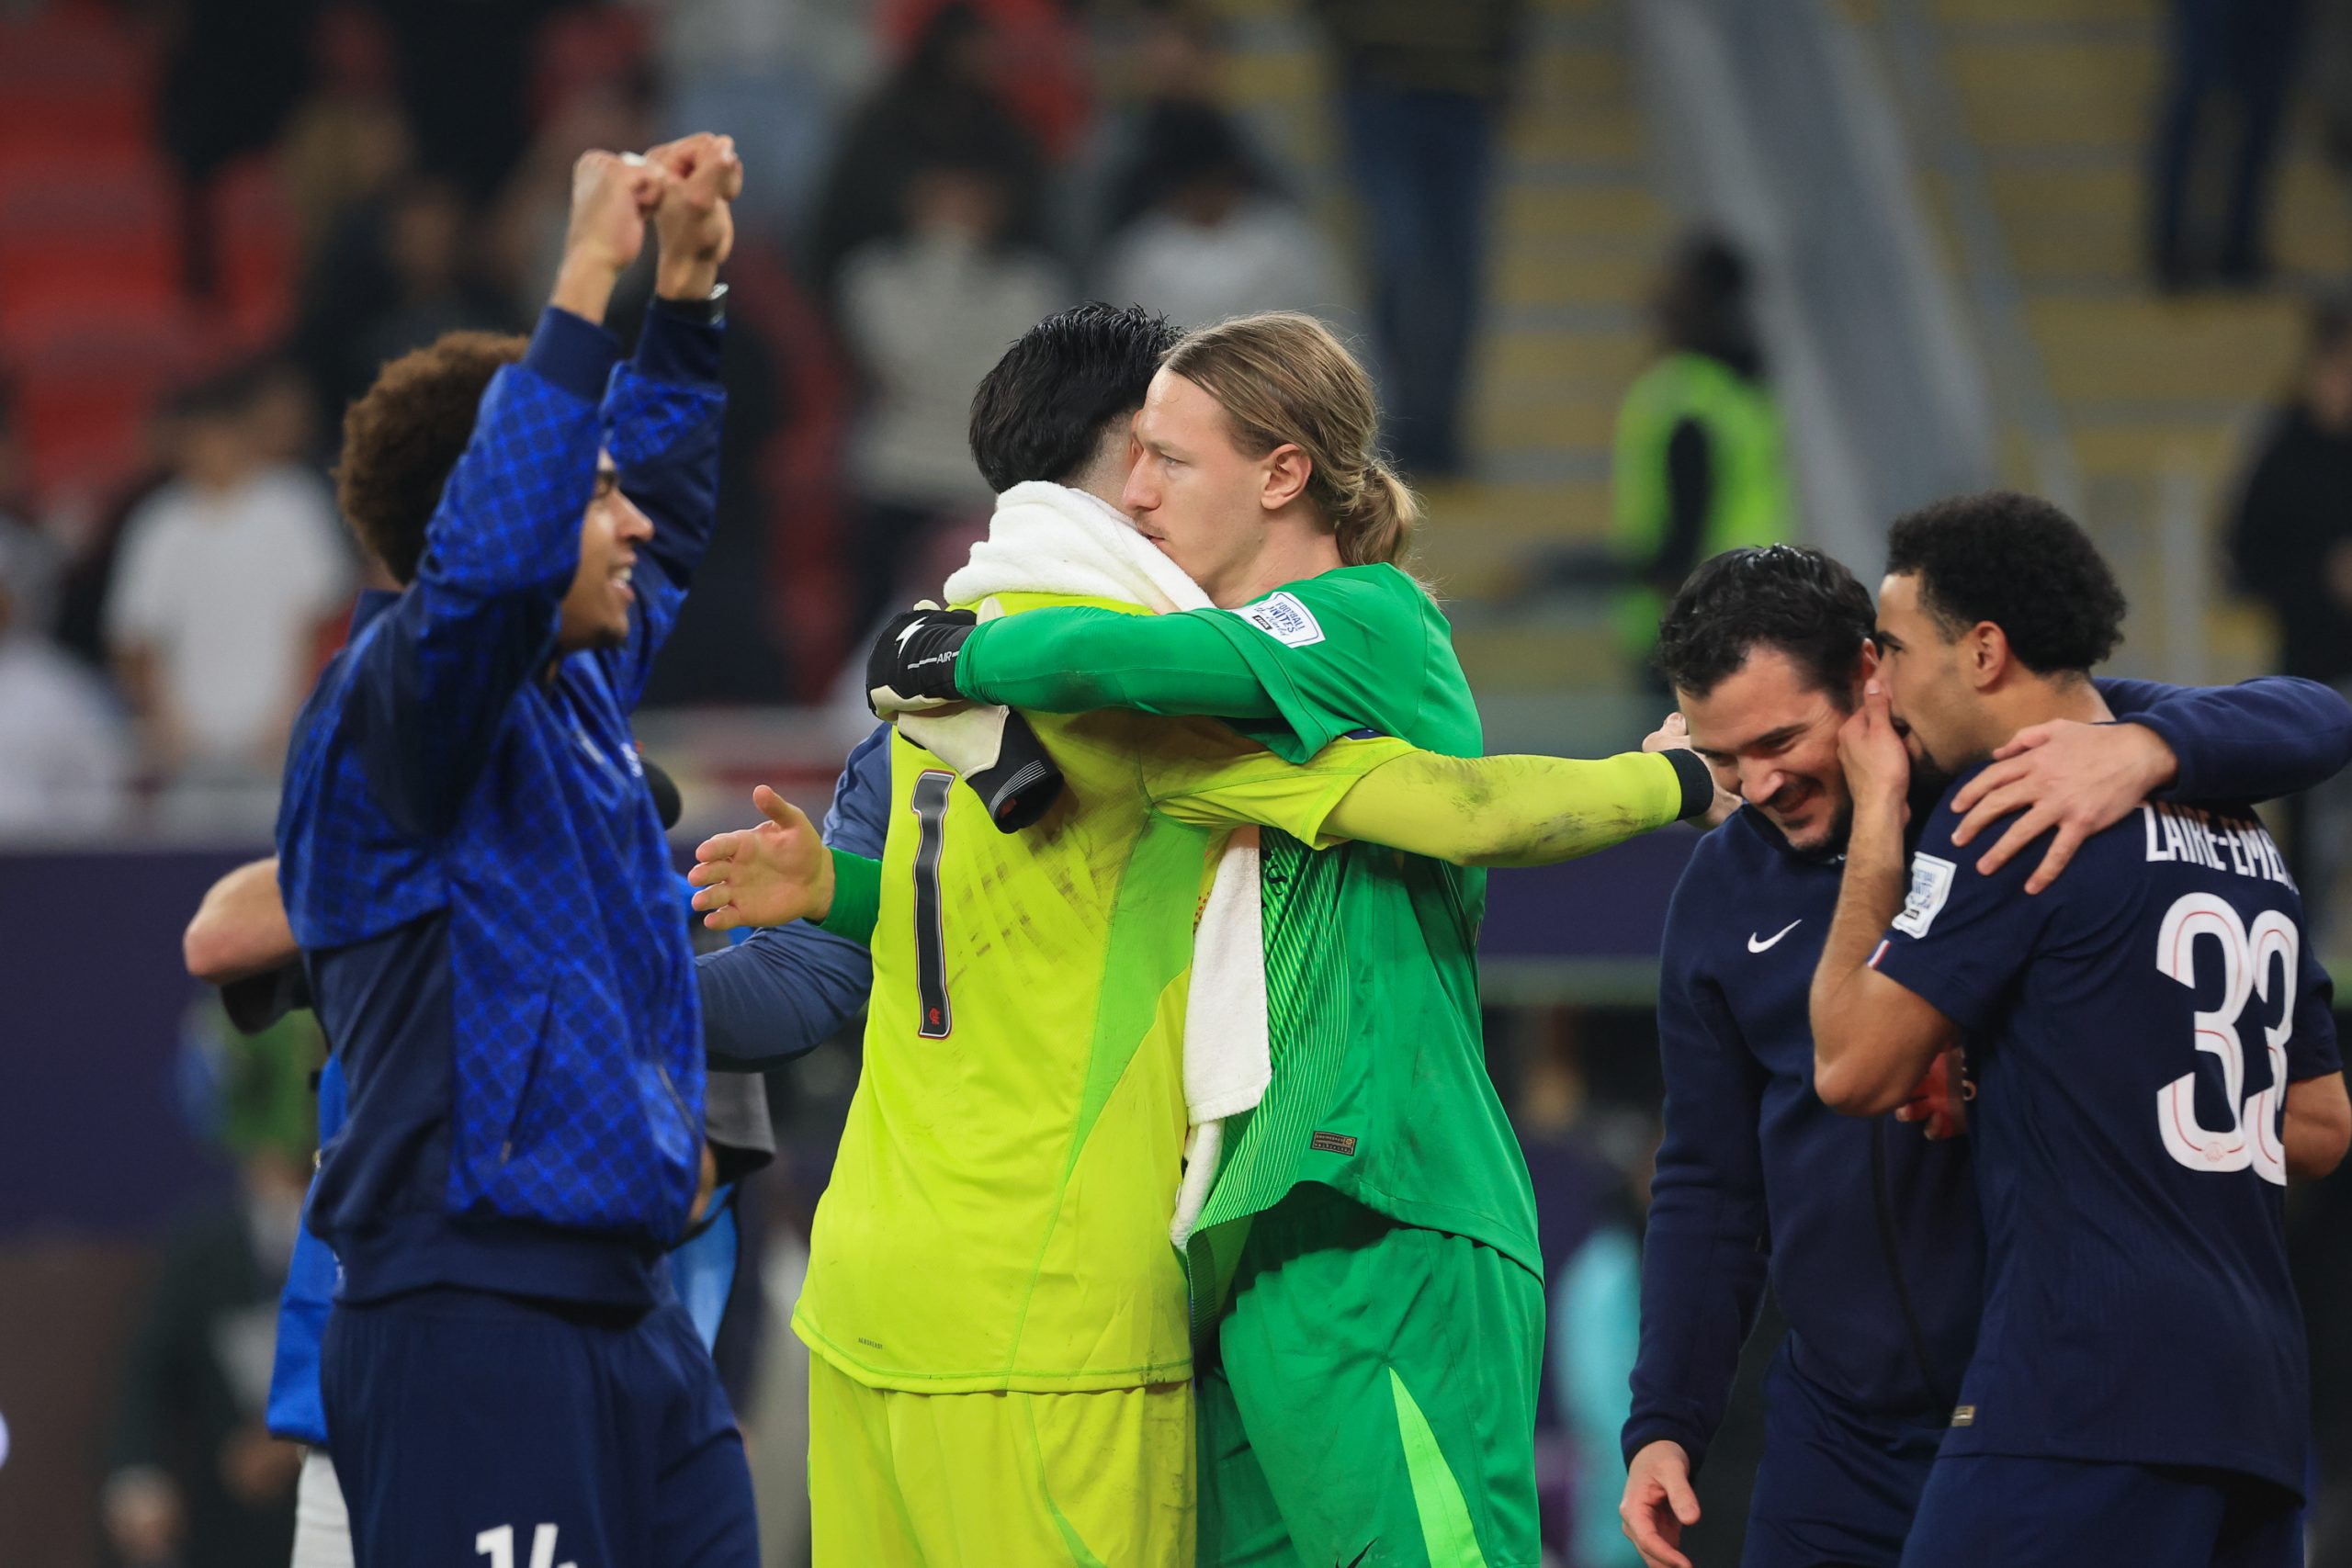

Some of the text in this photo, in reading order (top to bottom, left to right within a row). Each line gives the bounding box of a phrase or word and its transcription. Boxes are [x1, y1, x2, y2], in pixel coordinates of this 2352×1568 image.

[936, 650, 953, 664] AIR
[910, 770, 956, 1040] 1
[2156, 892, 2299, 1186] 33
